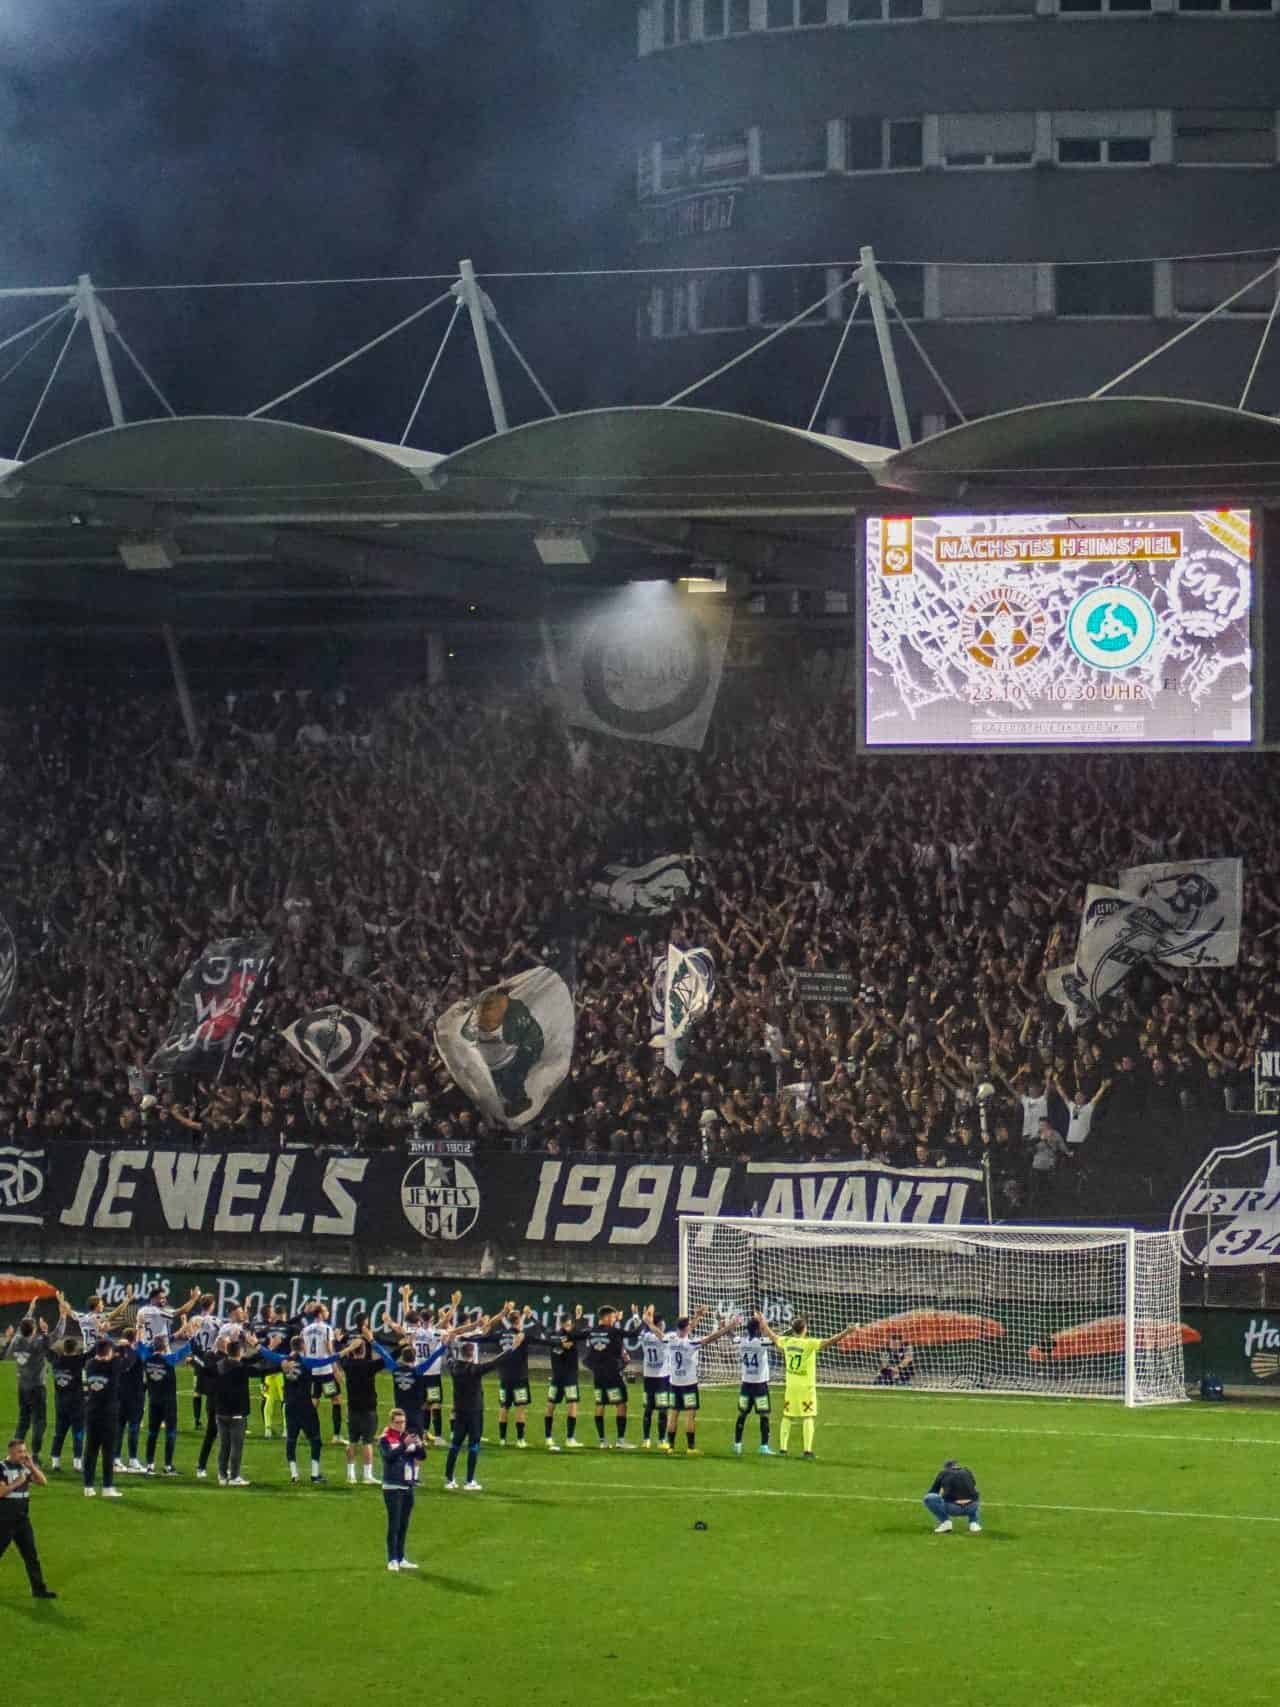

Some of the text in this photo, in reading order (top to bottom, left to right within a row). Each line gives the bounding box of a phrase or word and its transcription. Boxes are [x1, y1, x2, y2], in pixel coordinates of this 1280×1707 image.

[939, 534, 1177, 560] NÄCHSTES HEIMSPIEL
[1103, 683, 1145, 699] UHR
[59, 1149, 368, 1236] JEWELS
[406, 1188, 471, 1205] JEWELS
[525, 1161, 732, 1246] 1994
[760, 1175, 968, 1226] AVANTI
